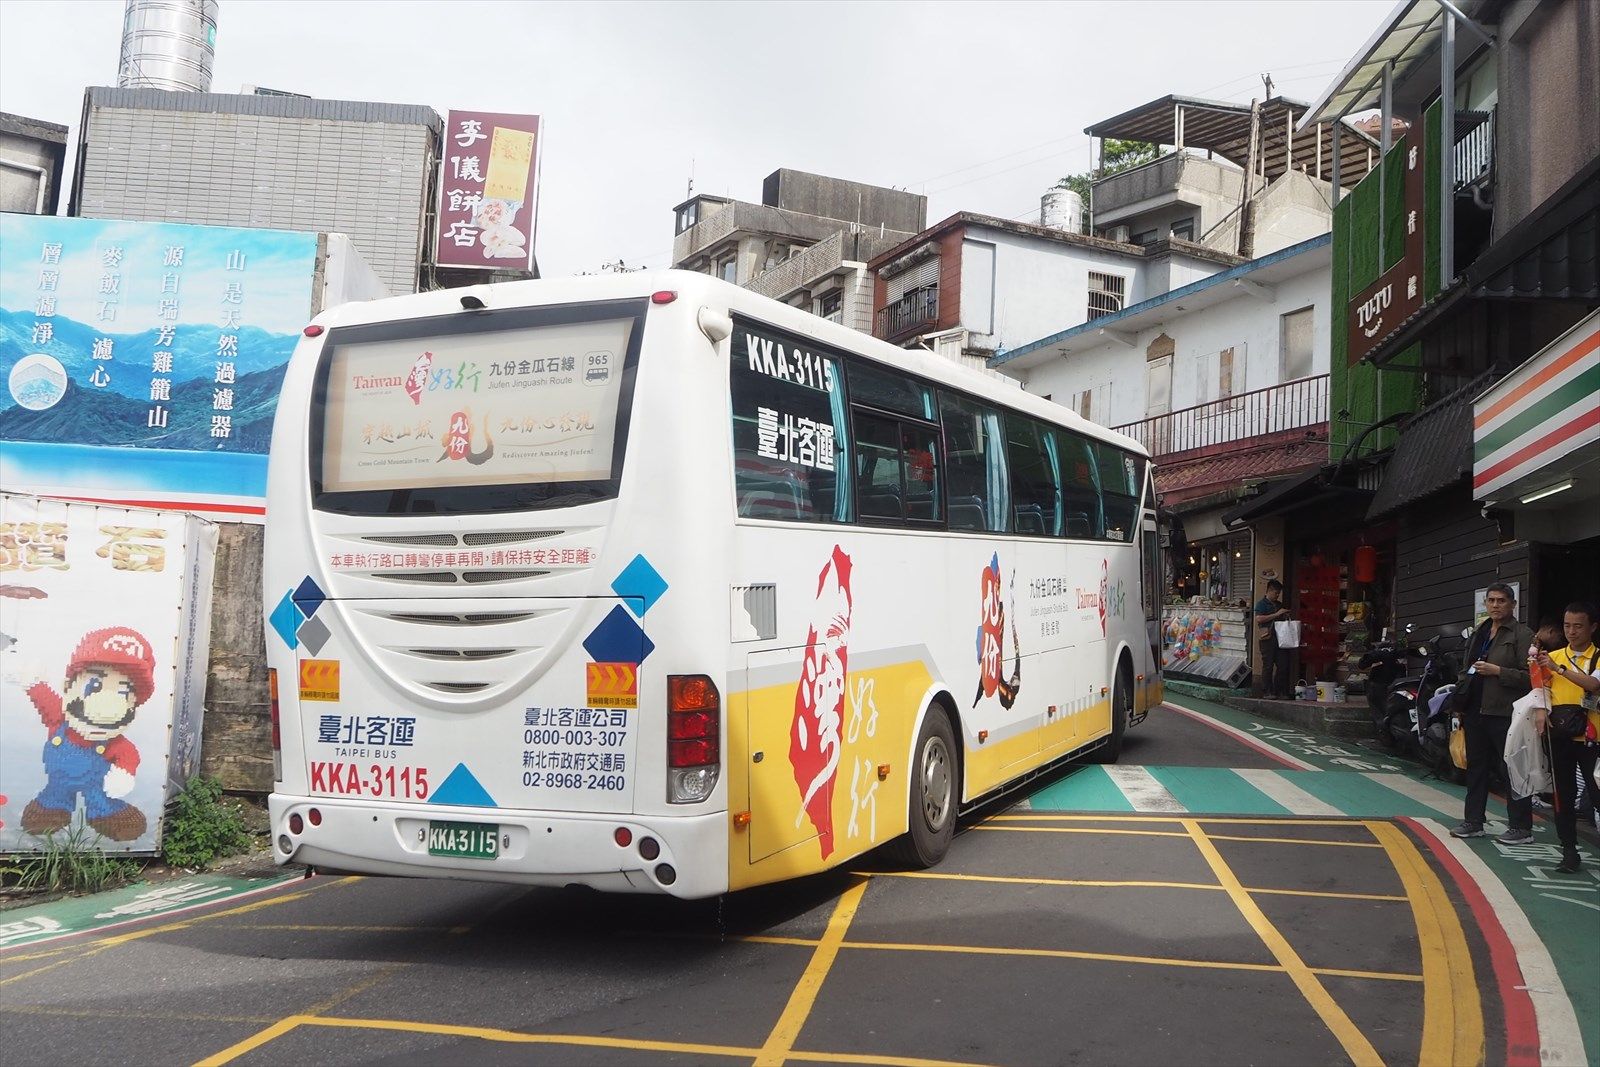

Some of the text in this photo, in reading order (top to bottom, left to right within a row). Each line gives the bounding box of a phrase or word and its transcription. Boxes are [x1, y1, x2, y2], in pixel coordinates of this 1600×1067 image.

[443, 119, 488, 247] 李儀餅店
[489, 356, 575, 377] 九份金瓜石線
[588, 355, 608, 365] 965
[746, 333, 834, 393] KKA-3115
[353, 374, 402, 390] Taiwan
[488, 376, 573, 390] Jiufen Jinguashi Route
[449, 416, 469, 454] 九份
[757, 406, 834, 472] 臺北客運
[539, 450, 568, 458] Amazing
[1075, 587, 1098, 610] Taiwan
[524, 707, 627, 728] 臺北客運公司
[317, 715, 416, 746] 臺北客運
[524, 729, 627, 746] 0800-003-307
[334, 747, 397, 759] TAIPEI BUS
[522, 751, 626, 773] 新北市政府交通局
[310, 761, 428, 799] KKA-3115
[523, 771, 625, 791] 02-8968-2460
